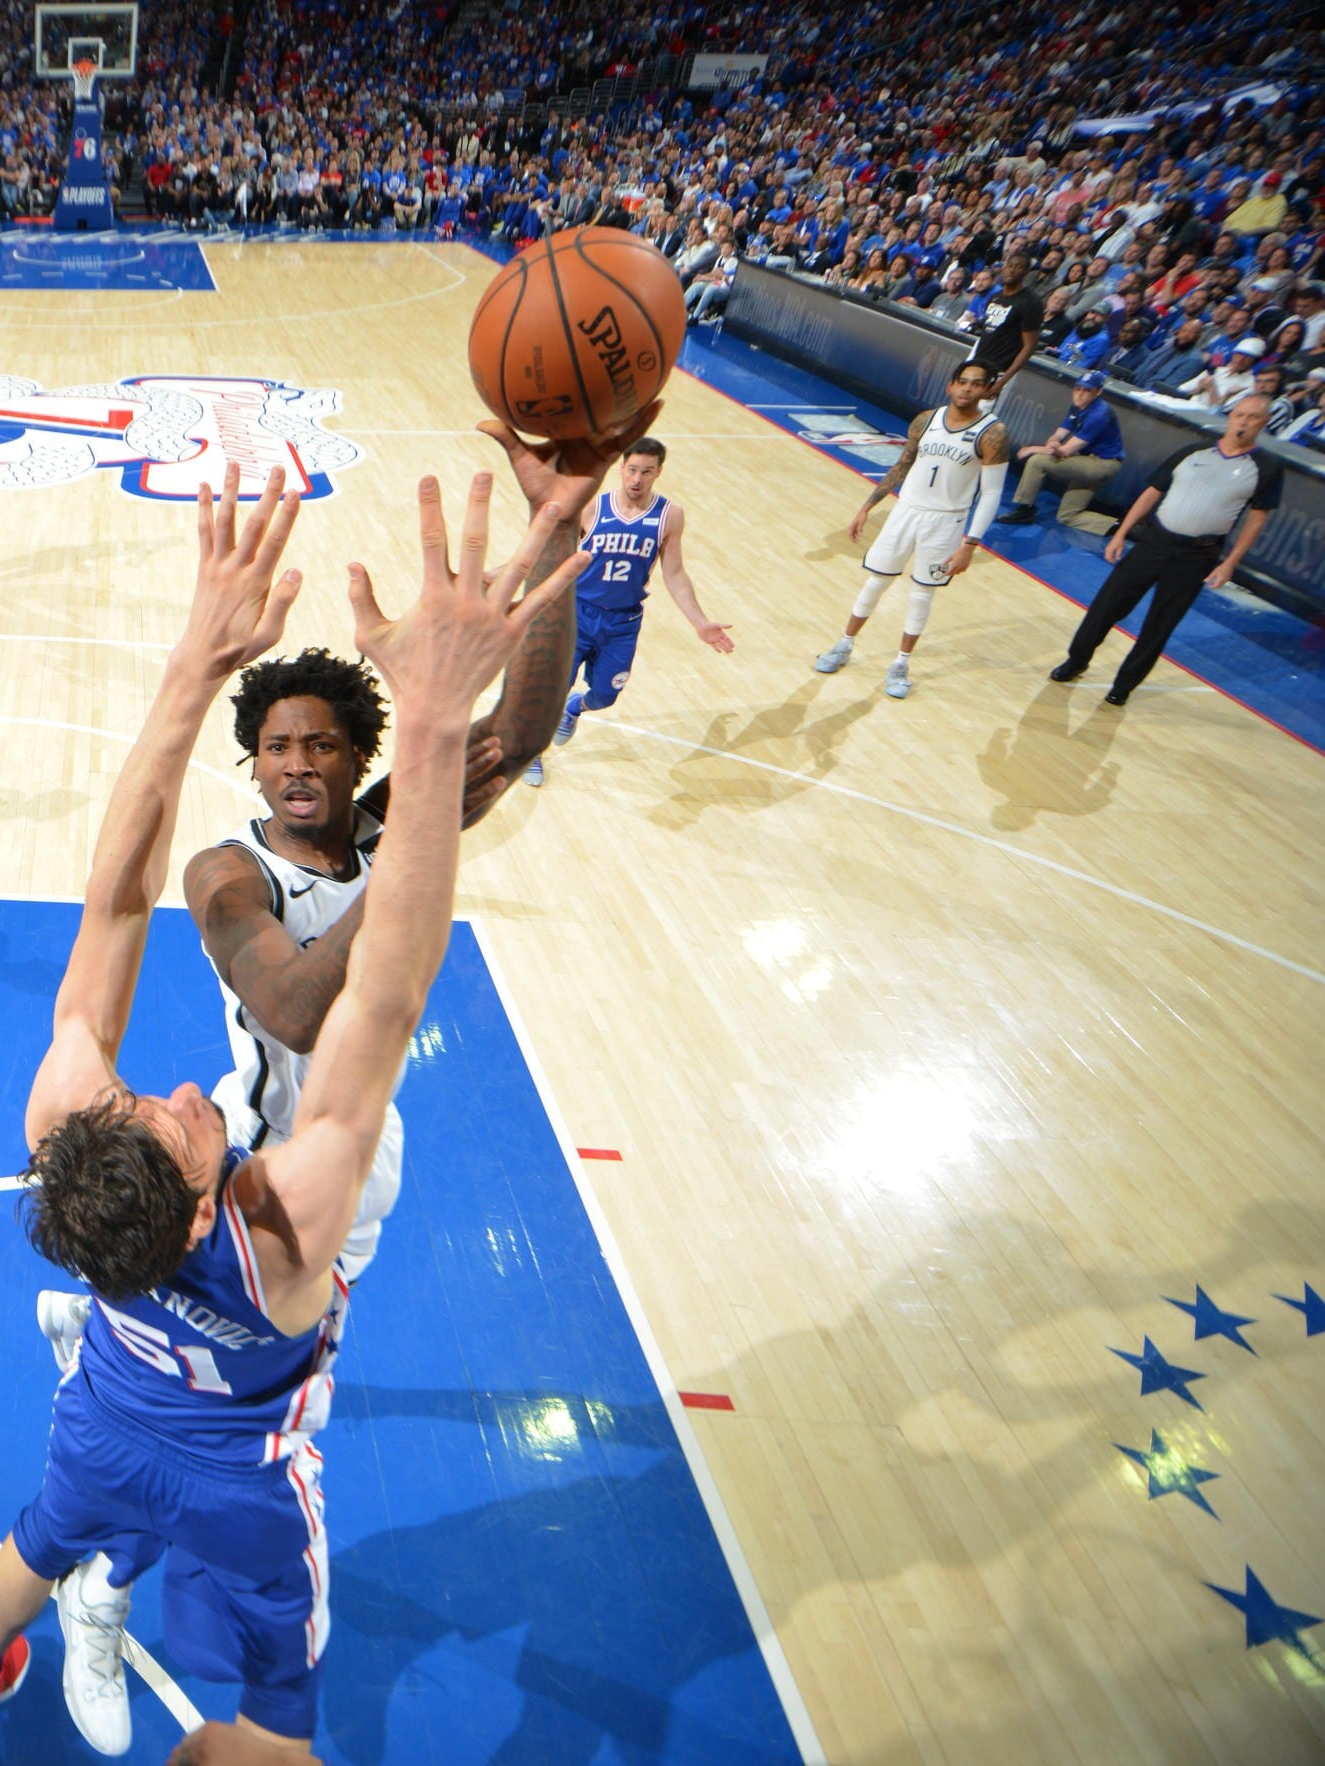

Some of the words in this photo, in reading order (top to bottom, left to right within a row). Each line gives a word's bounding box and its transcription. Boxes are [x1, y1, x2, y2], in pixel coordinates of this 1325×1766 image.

[73, 137, 97, 161] 76
[69, 186, 106, 206] PLAYOFFS
[577, 306, 640, 412] SPALDI
[918, 442, 974, 467] BROOKLYN
[929, 465, 940, 488] 1
[590, 533, 655, 558] PHILA
[602, 560, 632, 581] 12
[95, 1295, 233, 1396] 51
